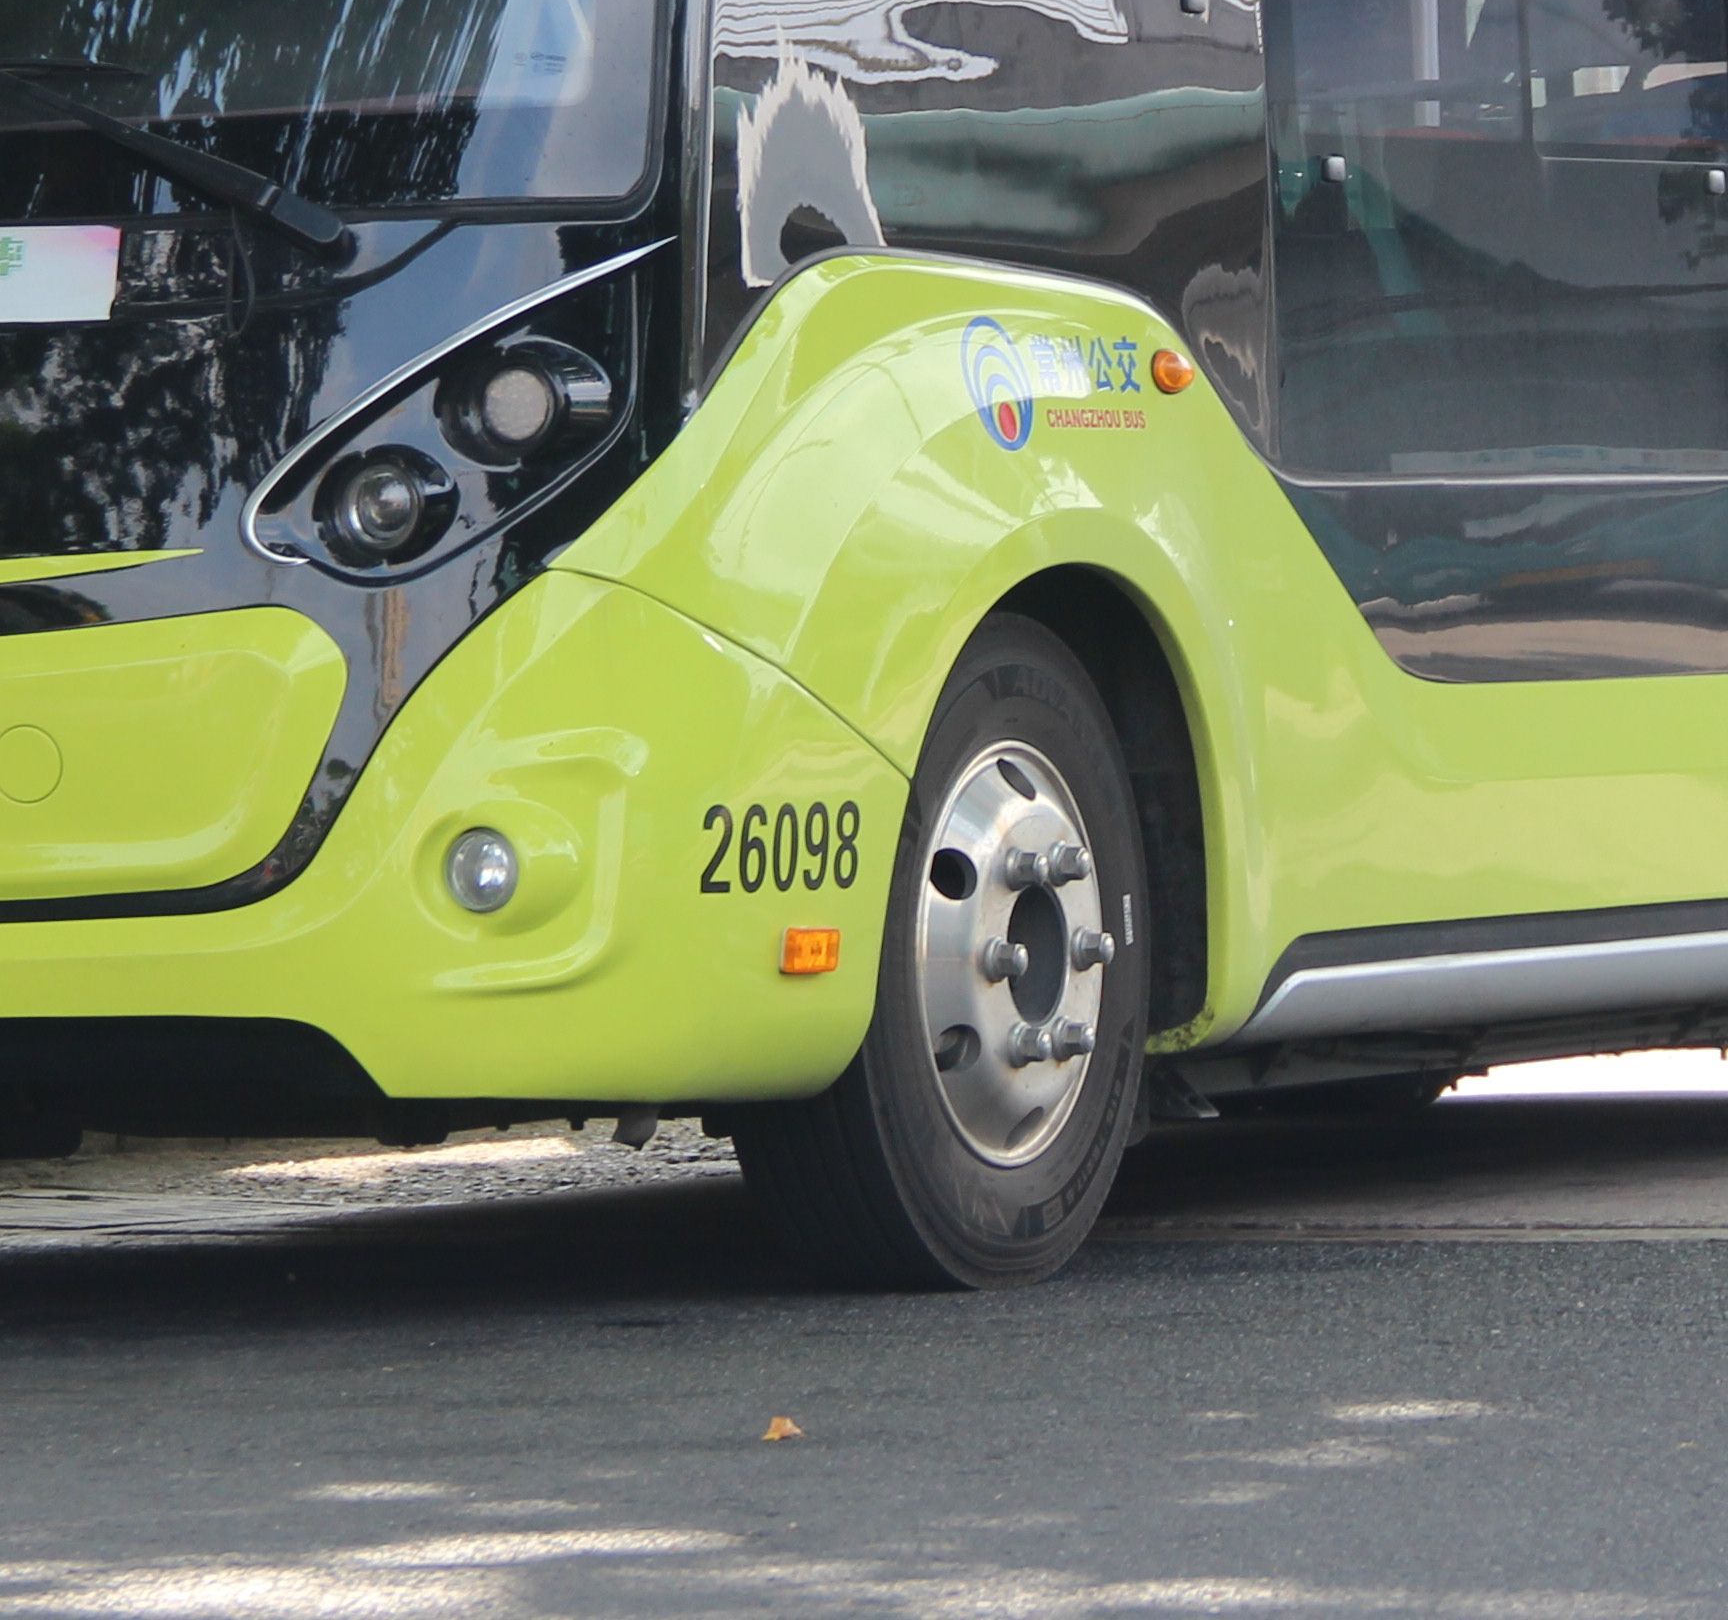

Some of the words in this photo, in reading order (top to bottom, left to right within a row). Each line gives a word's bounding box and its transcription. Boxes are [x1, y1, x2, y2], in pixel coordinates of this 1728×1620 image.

[1046, 408, 1122, 428] CHANGZHOU
[1124, 410, 1146, 429] BUS
[700, 800, 860, 894] 26098
